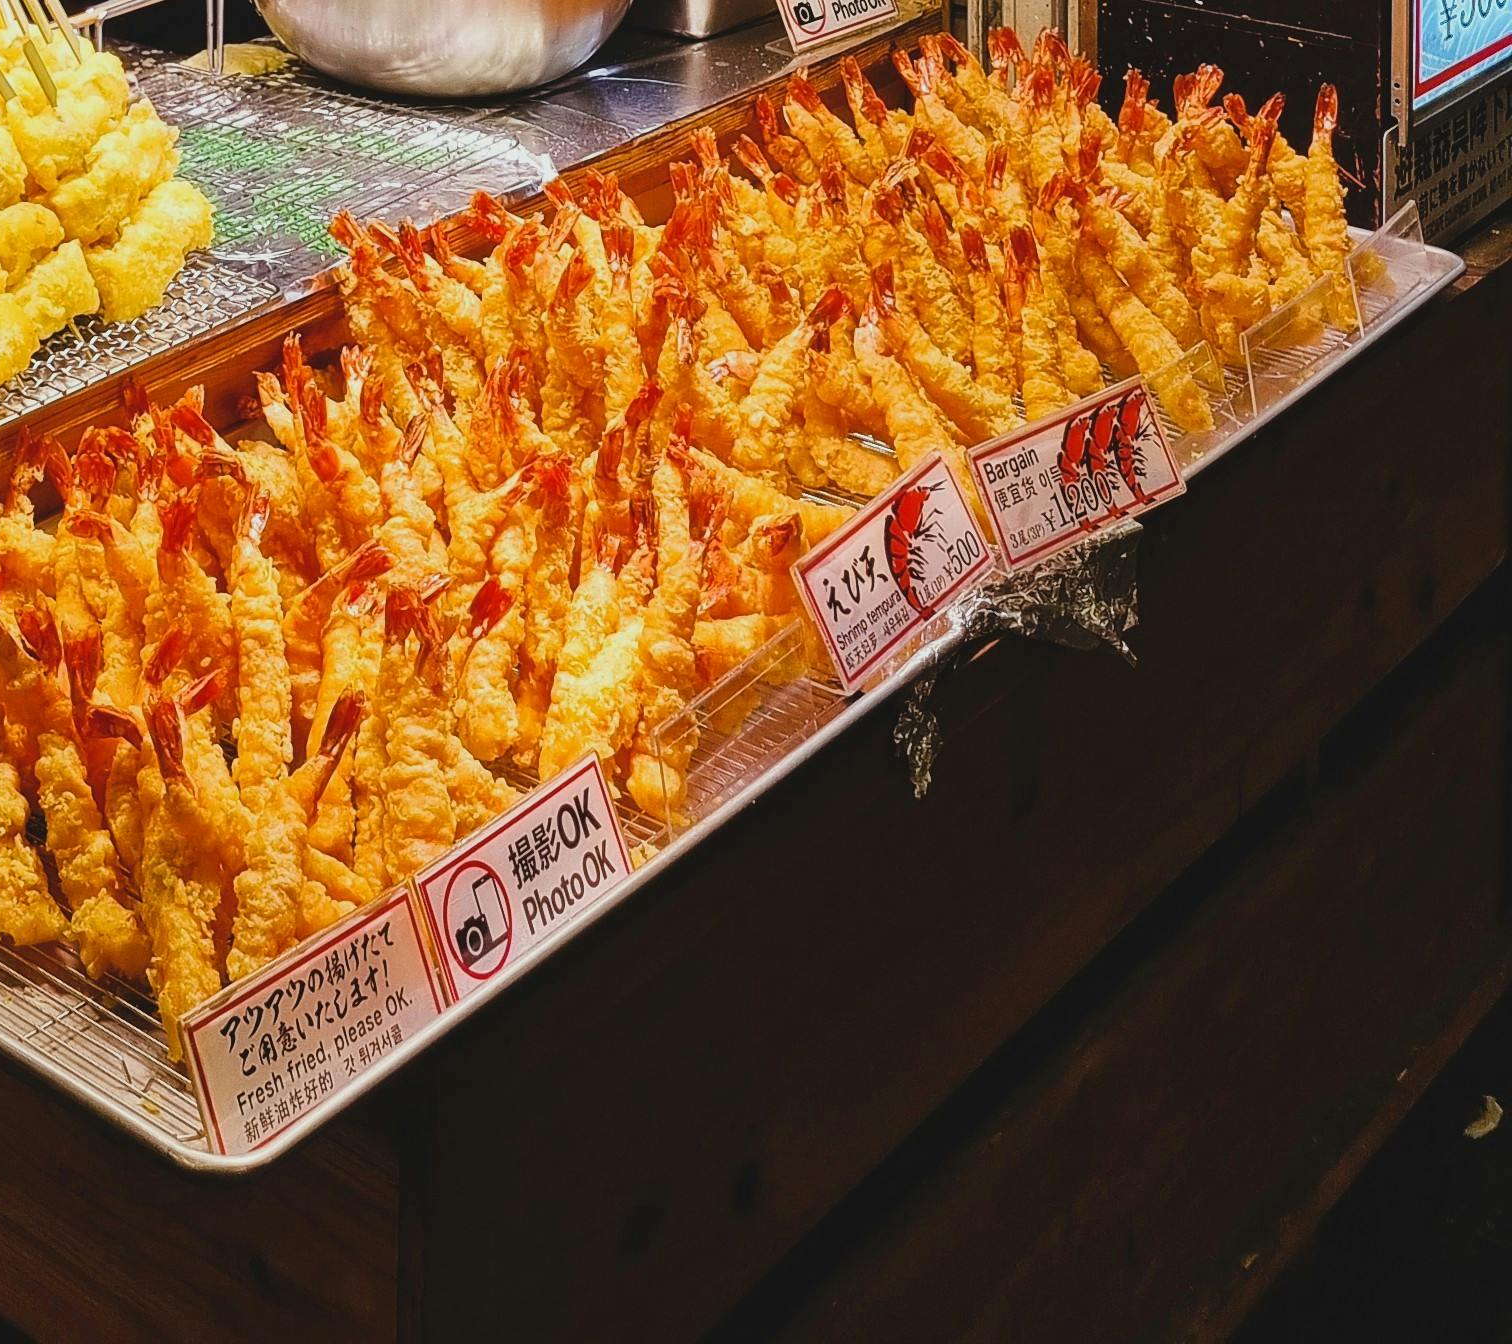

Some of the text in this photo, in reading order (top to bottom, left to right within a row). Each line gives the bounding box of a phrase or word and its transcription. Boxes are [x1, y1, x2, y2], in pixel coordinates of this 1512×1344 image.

[983, 446, 1040, 485] Bargain
[824, 544, 889, 623] えび天
[942, 529, 981, 583] ¥500
[835, 589, 902, 652] Shrimp tempura
[507, 787, 603, 891] 撮影OK
[236, 987, 414, 1117] Fresh fried, please OK.
[243, 1068, 335, 1145] 新鲜油炸好的
